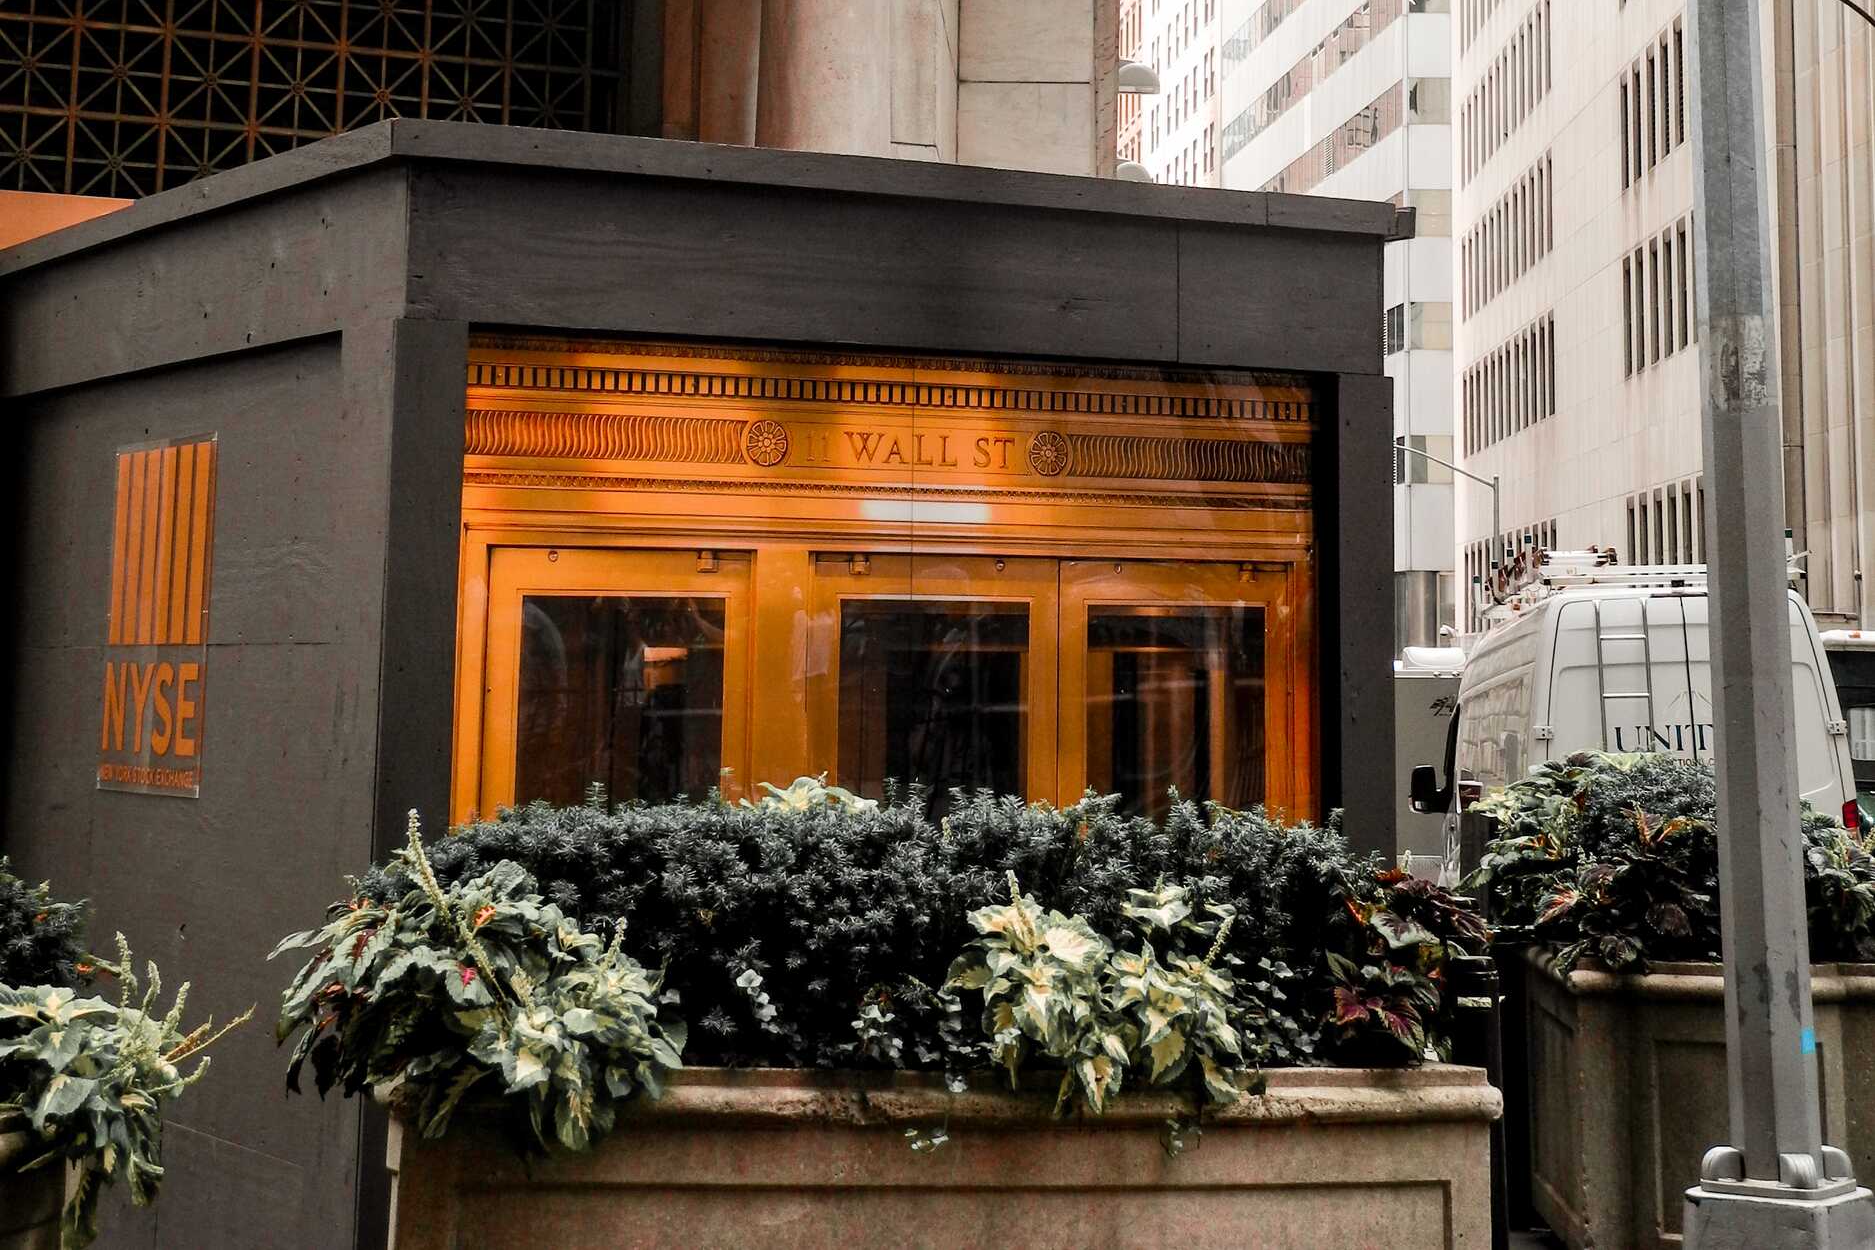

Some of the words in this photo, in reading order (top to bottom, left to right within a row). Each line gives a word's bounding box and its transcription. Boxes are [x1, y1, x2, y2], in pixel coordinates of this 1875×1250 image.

[842, 430, 958, 467] WALL
[972, 435, 1017, 469] ST
[101, 661, 200, 758] NYSE
